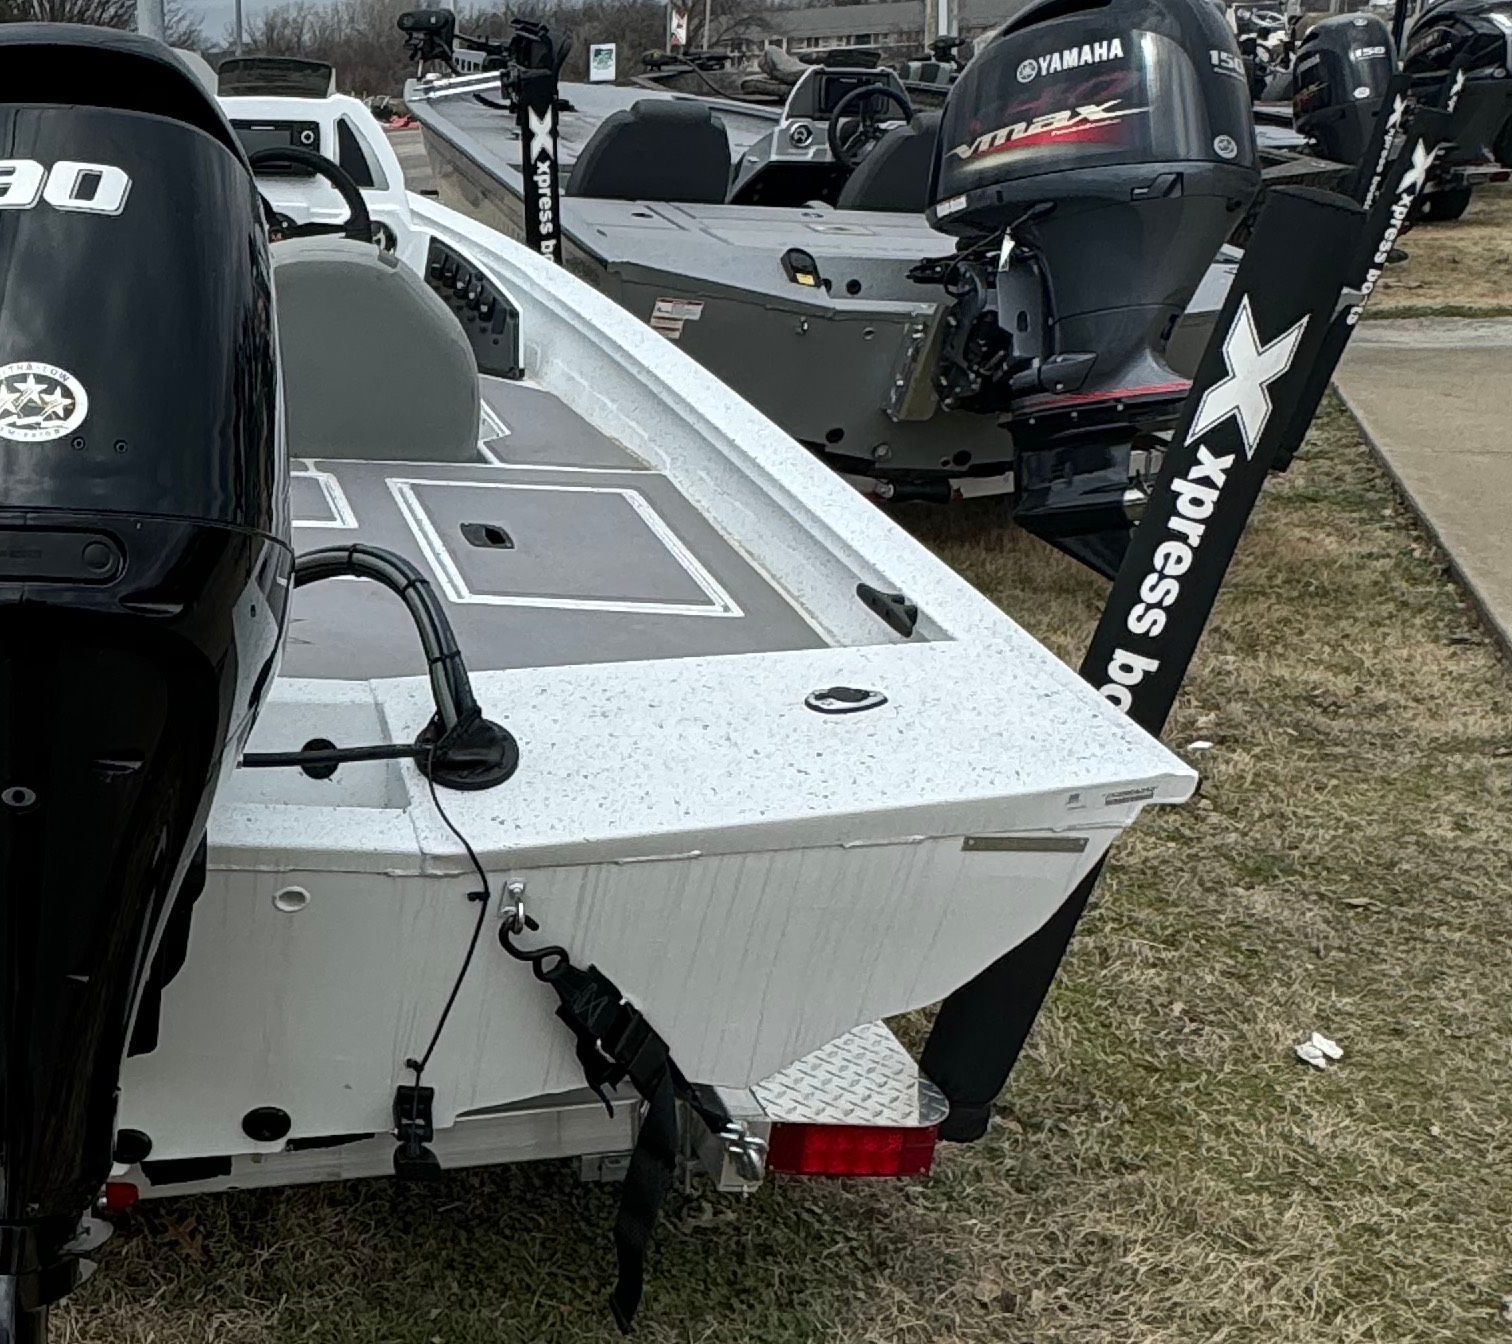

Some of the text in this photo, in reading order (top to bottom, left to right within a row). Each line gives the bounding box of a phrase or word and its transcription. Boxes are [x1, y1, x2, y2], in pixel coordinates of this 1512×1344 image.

[1039, 38, 1124, 77] YAMAHA
[1209, 50, 1246, 75] 150
[1355, 46, 1386, 57] 150
[533, 161, 553, 235] xpress
[1374, 192, 1414, 264] xpress
[1127, 444, 1236, 638] xpress
